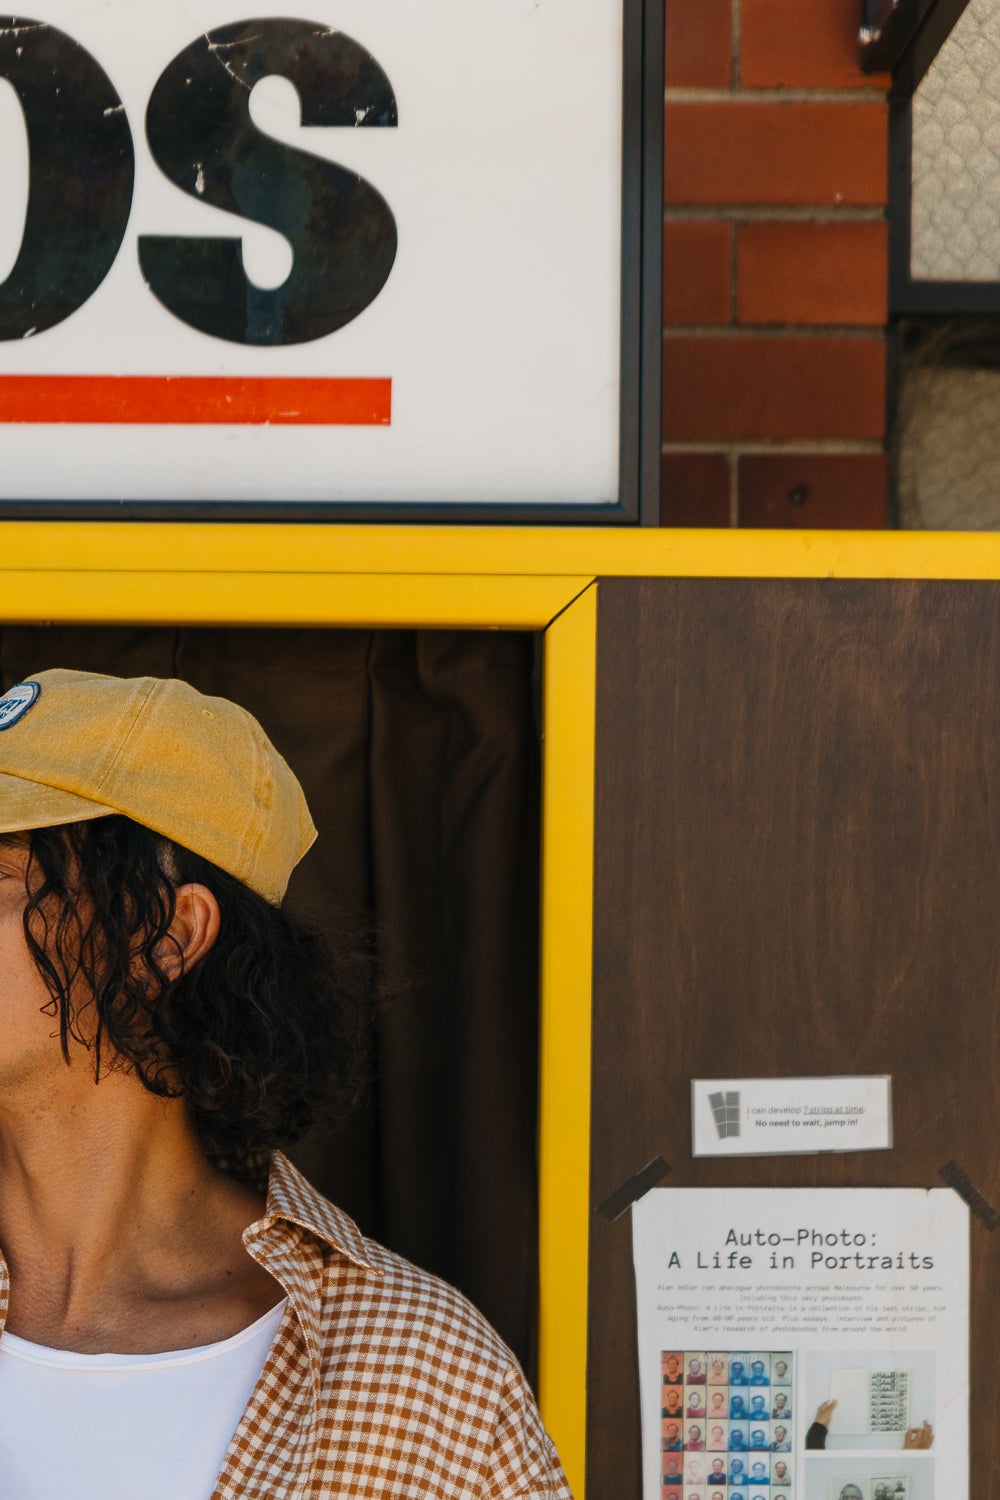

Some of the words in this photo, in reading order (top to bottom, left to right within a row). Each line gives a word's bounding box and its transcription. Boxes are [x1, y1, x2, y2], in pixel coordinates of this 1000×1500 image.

[768, 1105, 801, 1116] develop
[803, 1105, 809, 1113] 7
[809, 1105, 833, 1114] strips
[755, 1119, 767, 1127] No
[769, 1119, 790, 1127] need
[791, 1119, 801, 1127] to
[802, 1118, 823, 1128] wait,
[824, 1118, 846, 1128] jump
[847, 1117, 859, 1126] in!
[724, 1228, 877, 1246] Auto-Photo:
[667, 1250, 682, 1269] A
[696, 1250, 752, 1269] Life
[769, 1250, 795, 1269] in
[811, 1251, 934, 1269] Portraits
[657, 1284, 674, 1292] Alan
[718, 1284, 751, 1293] analogue
[755, 1284, 800, 1293] photobooths
[874, 1284, 886, 1292] for
[801, 1295, 818, 1303] very
[692, 1315, 709, 1323] from
[876, 1315, 888, 1323] and
[929, 1315, 937, 1323] of
[772, 1325, 817, 1333] photobooths
